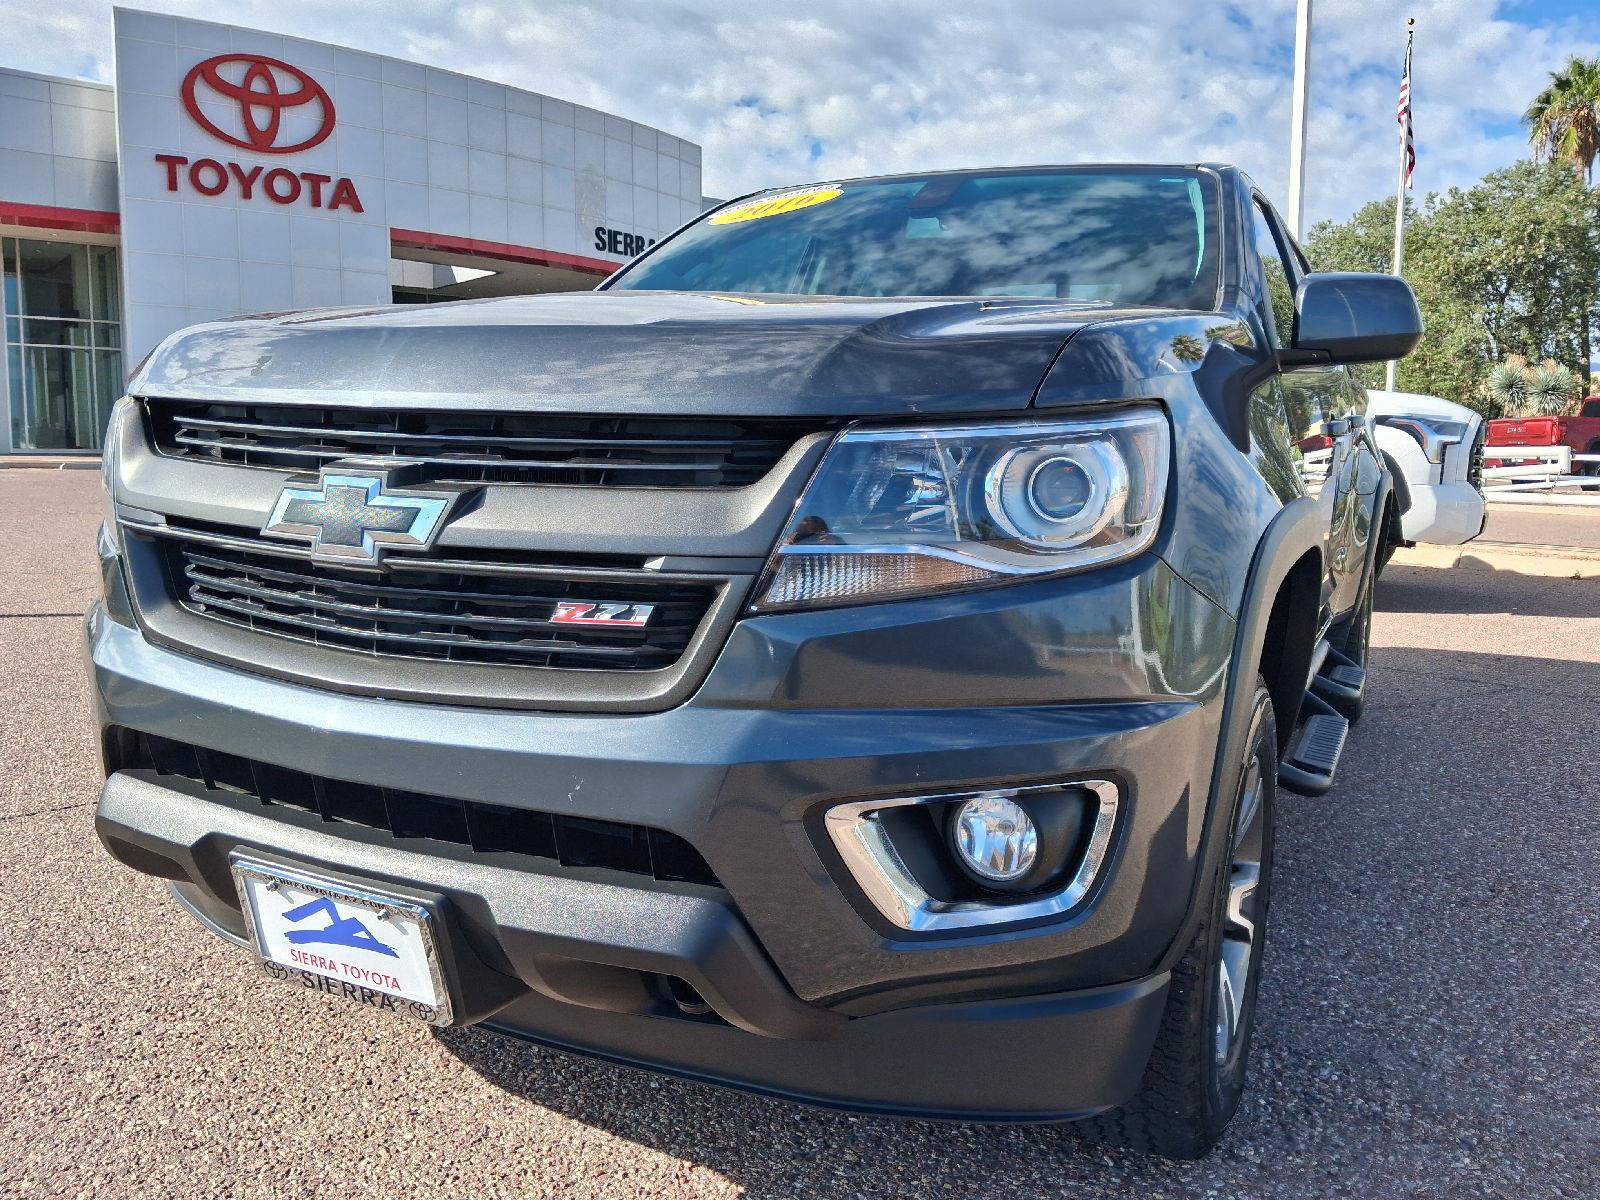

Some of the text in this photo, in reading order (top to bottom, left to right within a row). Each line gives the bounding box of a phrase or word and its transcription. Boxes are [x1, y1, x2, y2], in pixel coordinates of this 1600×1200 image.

[155, 154, 364, 213] TOYOTA
[594, 226, 656, 257] SIERR
[548, 601, 655, 627] Z71
[290, 948, 402, 992] SIERRA TOYOTA
[301, 971, 396, 1012] SIERRA
